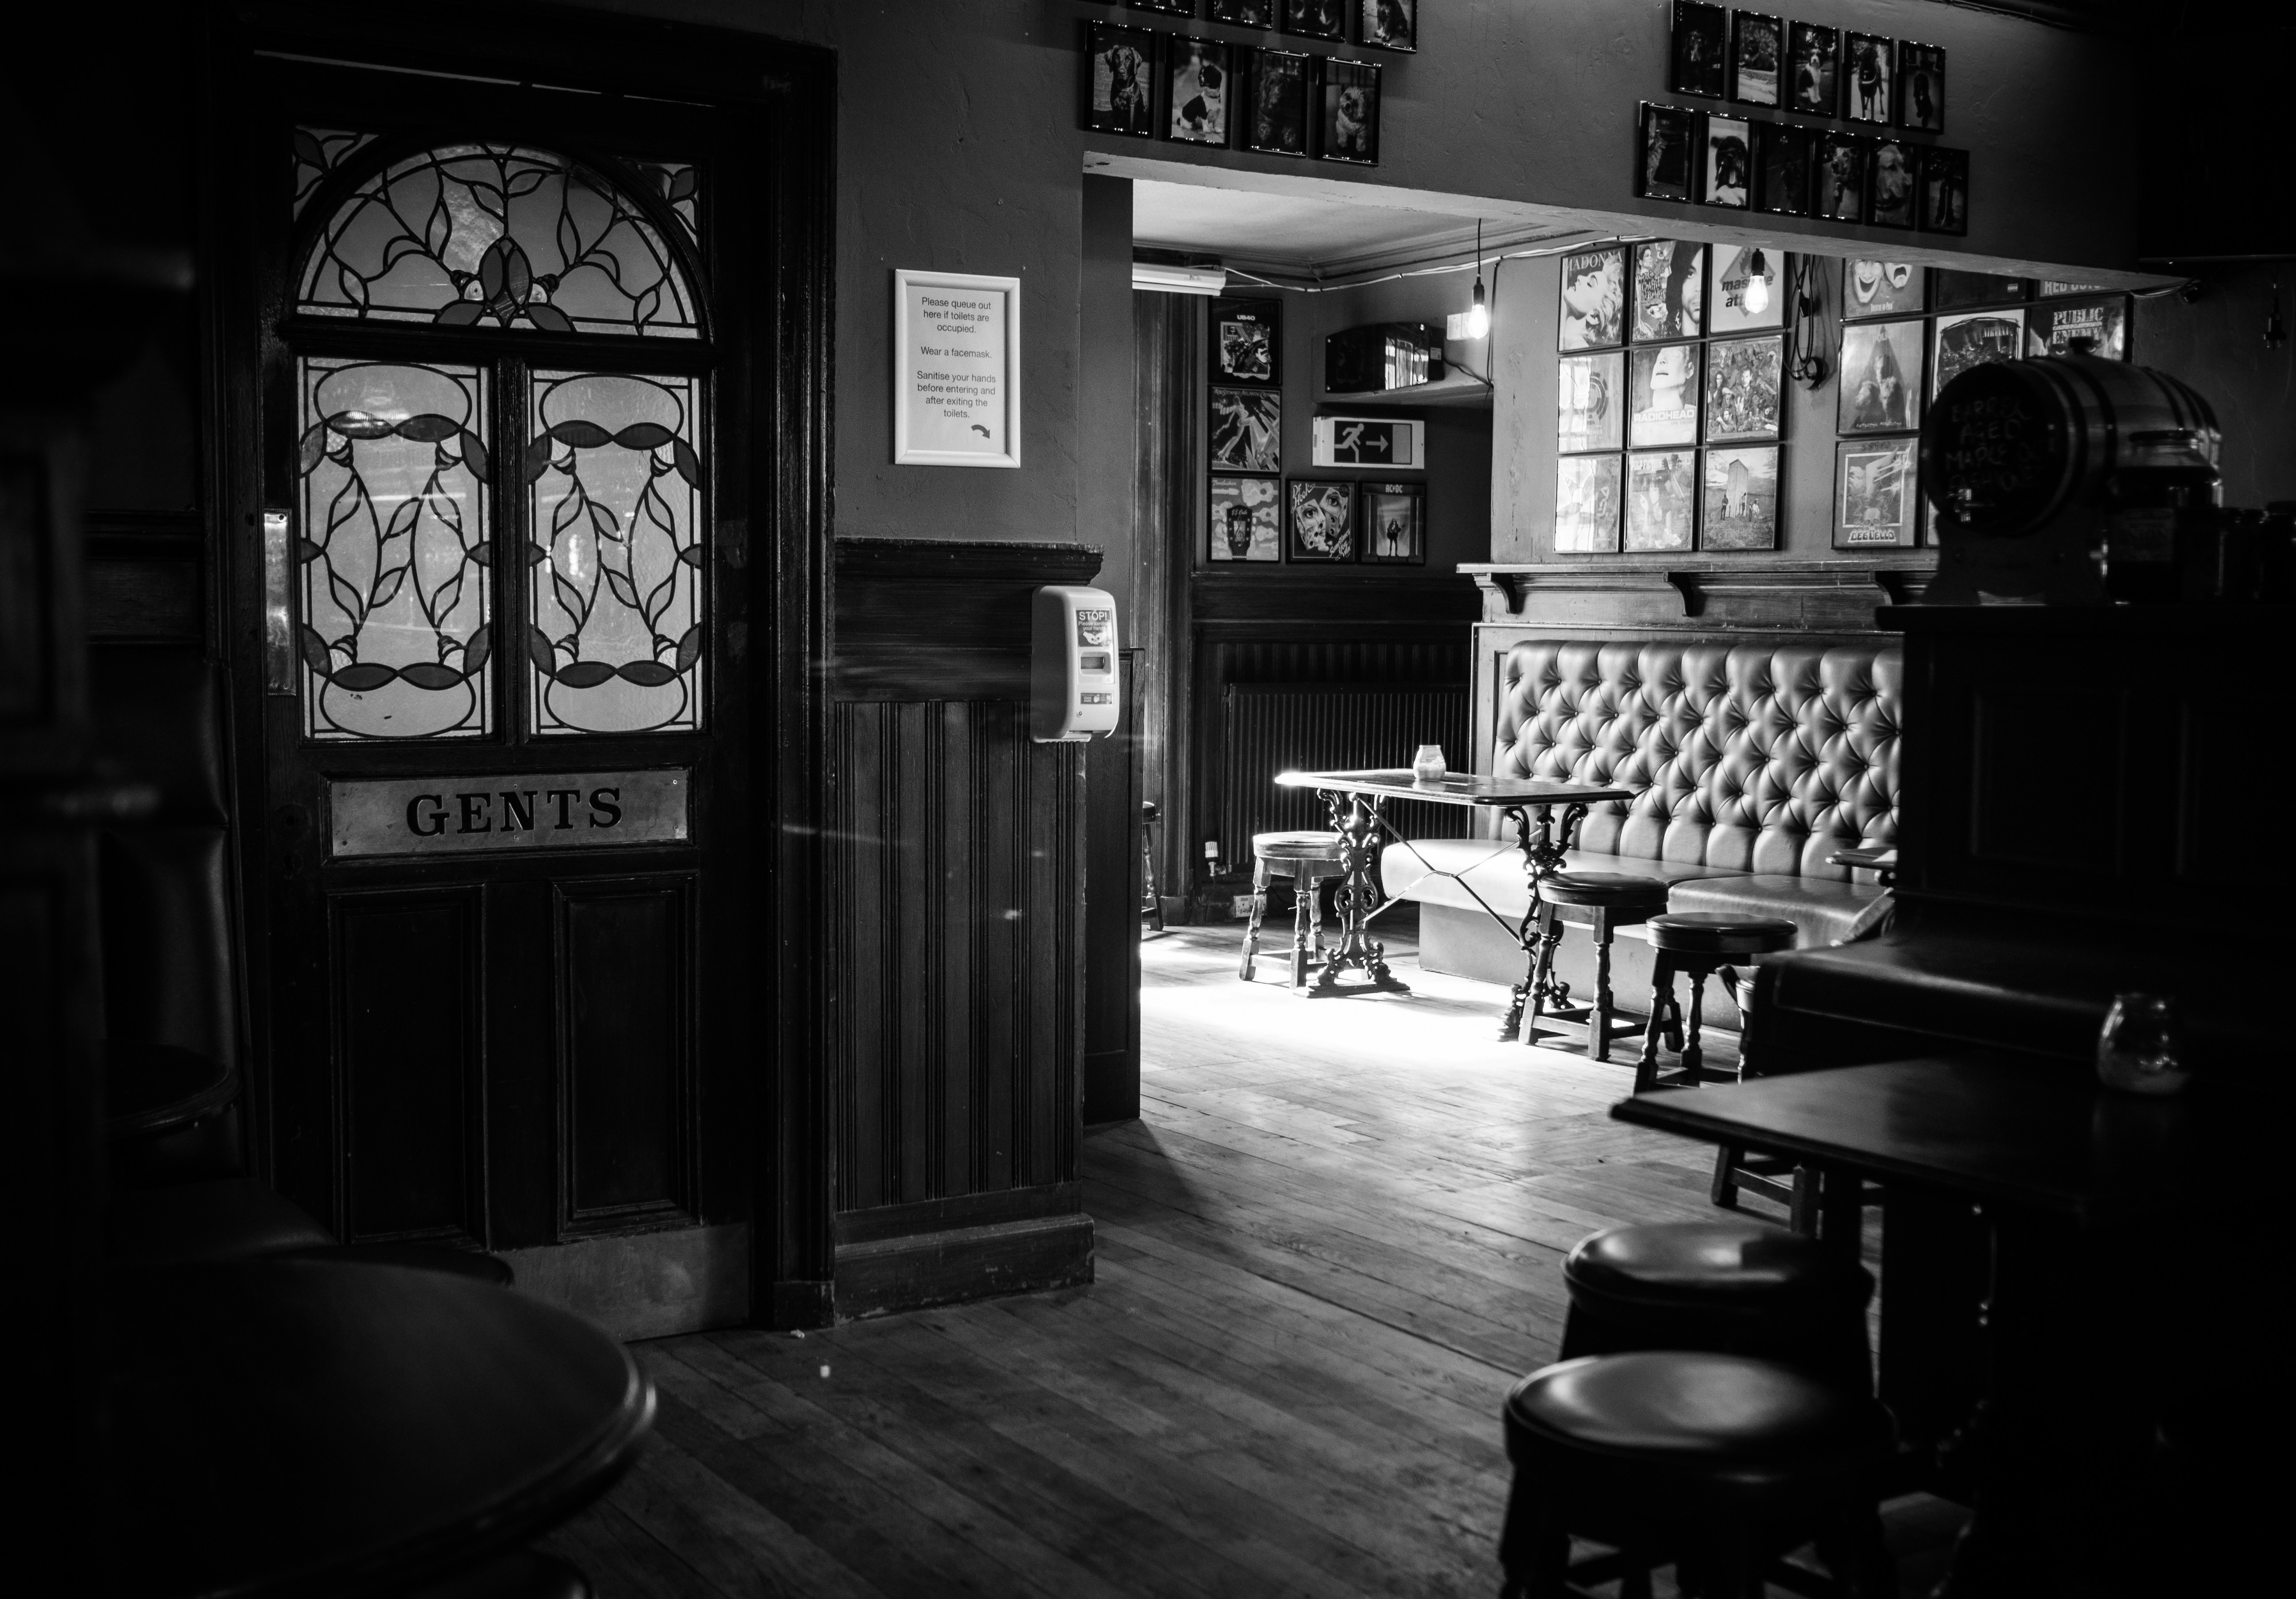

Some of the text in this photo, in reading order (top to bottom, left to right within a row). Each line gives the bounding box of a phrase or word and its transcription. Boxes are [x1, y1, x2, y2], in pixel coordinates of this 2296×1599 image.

[1566, 250, 1622, 272] MADONNA
[1722, 276, 1773, 291] mase
[922, 297, 949, 307] Please
[951, 301, 976, 309] queue
[923, 310, 941, 318] here
[951, 312, 974, 321] toilets
[2053, 307, 2103, 325] PUBLIC
[937, 324, 976, 334] occupied.
[921, 346, 942, 355] Wear
[952, 348, 992, 358] facemask.
[917, 371, 996, 383] Sanitise your hands
[918, 383, 943, 392] before
[946, 385, 978, 396] entering
[926, 396, 944, 404] after
[946, 397, 973, 408] exiting
[1950, 394, 2035, 423] BARREL
[944, 409, 970, 418] toilets.
[1633, 409, 1695, 423] RADIOHEAD
[1956, 418, 2023, 445] AGED
[1944, 442, 2009, 472] MAPLE
[1079, 611, 1107, 621] STOP!
[406, 787, 622, 837] GENTS
